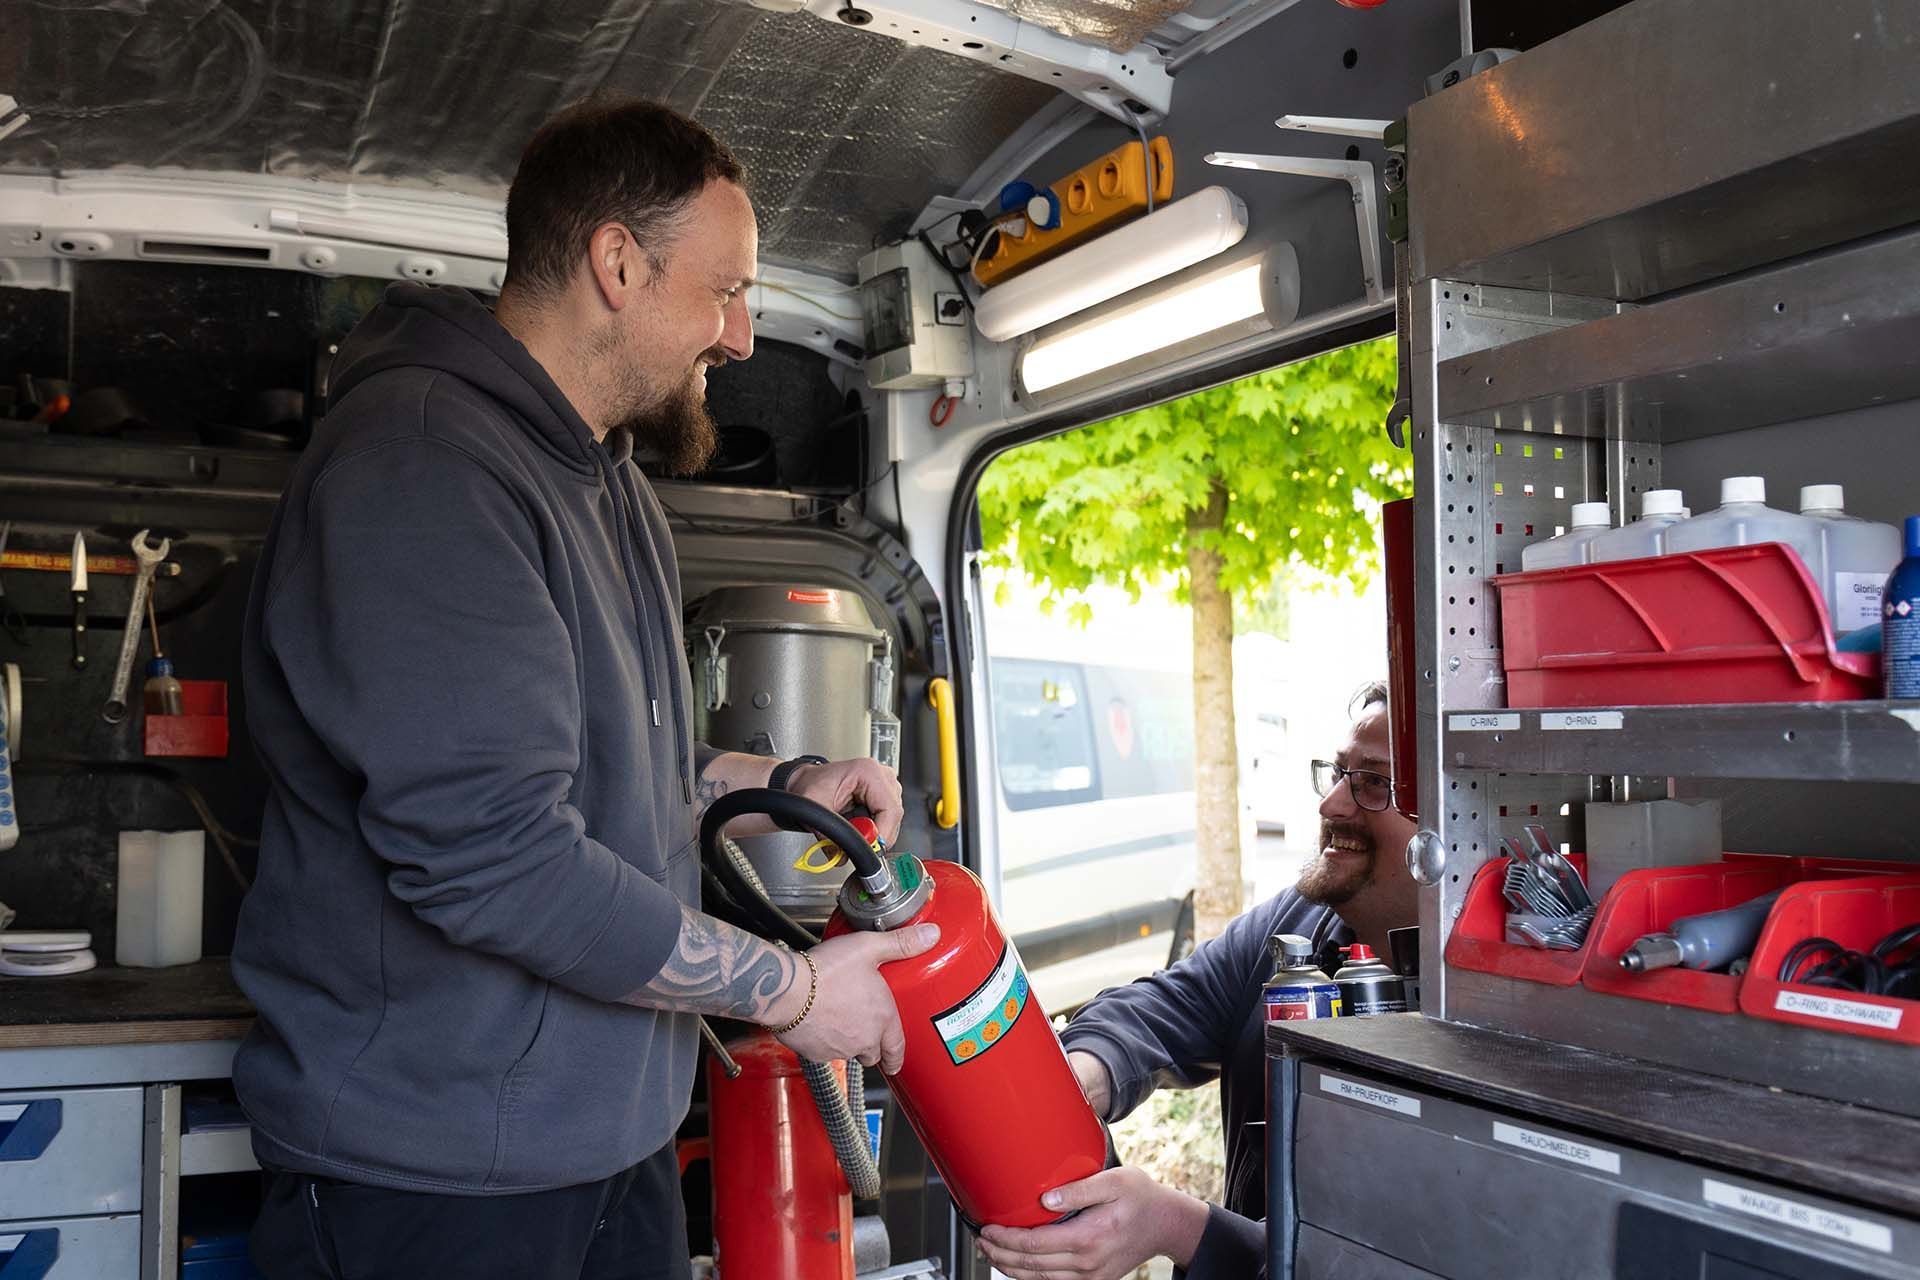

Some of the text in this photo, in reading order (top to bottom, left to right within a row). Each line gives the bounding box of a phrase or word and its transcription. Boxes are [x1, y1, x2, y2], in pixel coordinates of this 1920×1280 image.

[1471, 717, 1498, 727] O-RING
[1565, 715, 1597, 726] O-RING
[1785, 996, 1893, 1023] O-RING SCHWARZ
[1340, 1082, 1399, 1107] RM-PRUEFKOPF
[1520, 1132, 1592, 1161] RAUCHMELDER
[1739, 1192, 1782, 1218] WAAGE
[1790, 1207, 1810, 1224] BIS
